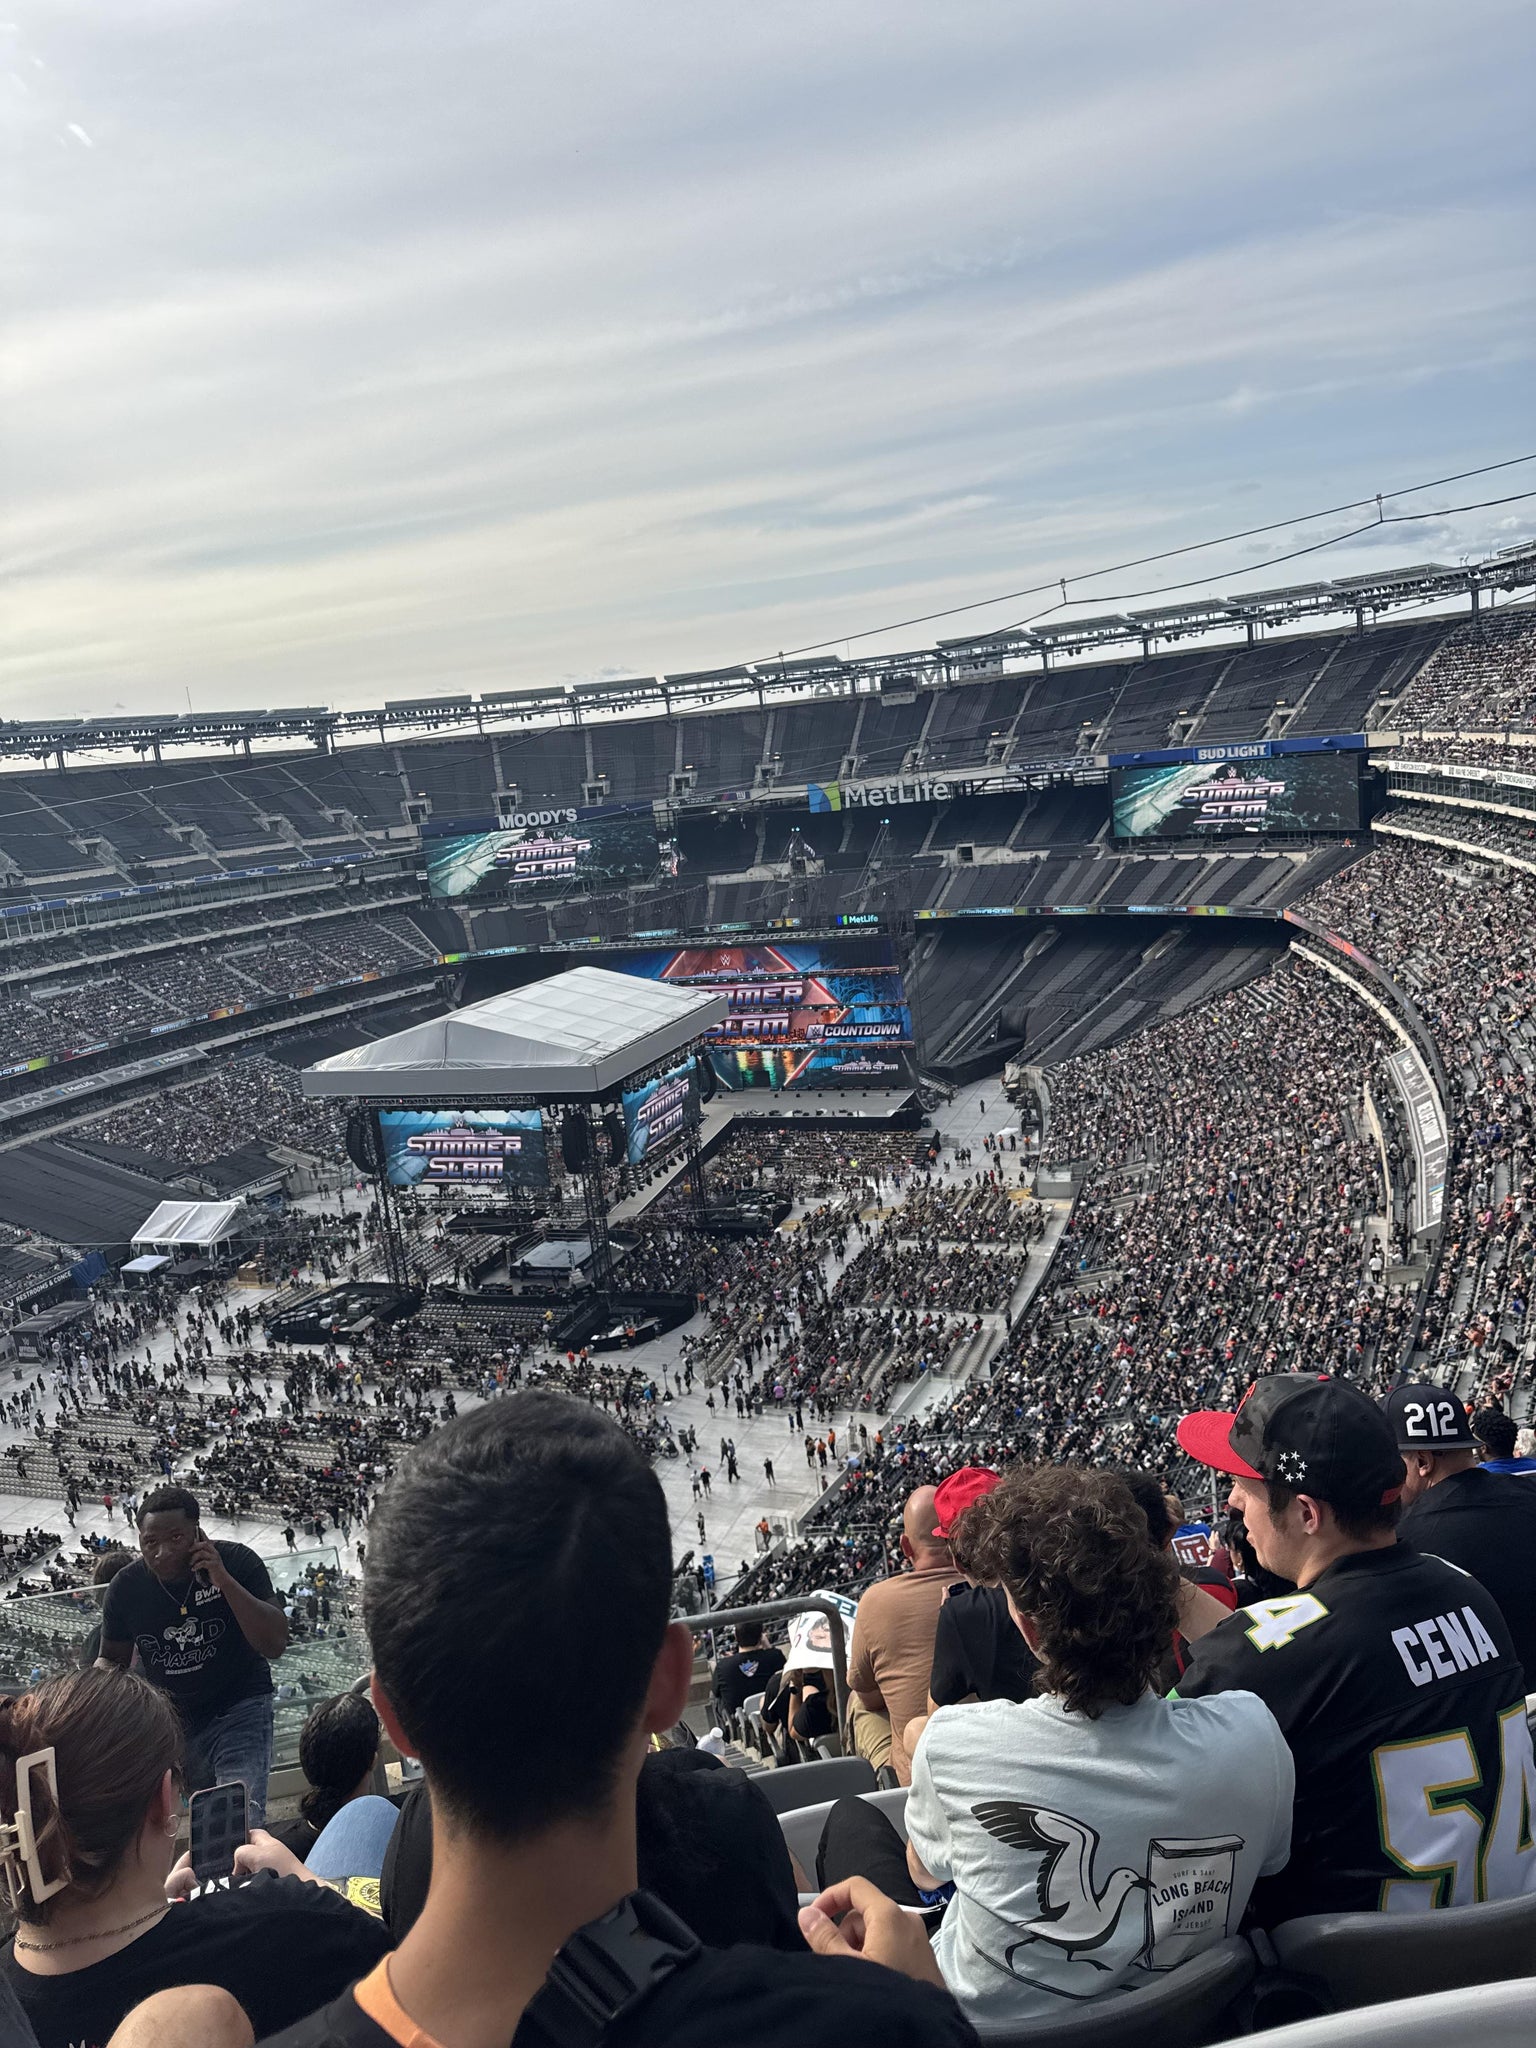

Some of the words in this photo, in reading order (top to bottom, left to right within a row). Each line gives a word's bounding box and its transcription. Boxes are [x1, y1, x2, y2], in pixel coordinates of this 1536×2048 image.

[1198, 747, 1226, 761] BUD
[1227, 744, 1267, 758] LIGHT
[844, 778, 950, 808] MetLife
[1182, 782, 1286, 803] SUMMER
[498, 808, 578, 830] MOODY'S
[1199, 799, 1268, 819] SLAM
[495, 839, 591, 864] SUMMER
[513, 857, 577, 879] SLAM
[849, 914, 879, 925] MetLife
[824, 1024, 902, 1037] COUNTDOWN
[637, 1078, 690, 1125] SUMMER
[648, 1103, 683, 1145] SLAM
[405, 1136, 522, 1157] SUMMER
[427, 1157, 504, 1178] SLAM
[15, 1282, 49, 1303] RESTROOMS
[49, 1279, 54, 1287] &
[1402, 1401, 1458, 1437] 212
[1242, 1594, 1330, 1653] 4
[150, 1645, 217, 1668] MAFIA
[1391, 1606, 1500, 1687] CENA
[1152, 1882, 1189, 1907] LONG
[1194, 1879, 1231, 1896] BEACH
[1173, 1899, 1214, 1923] ISLAND
